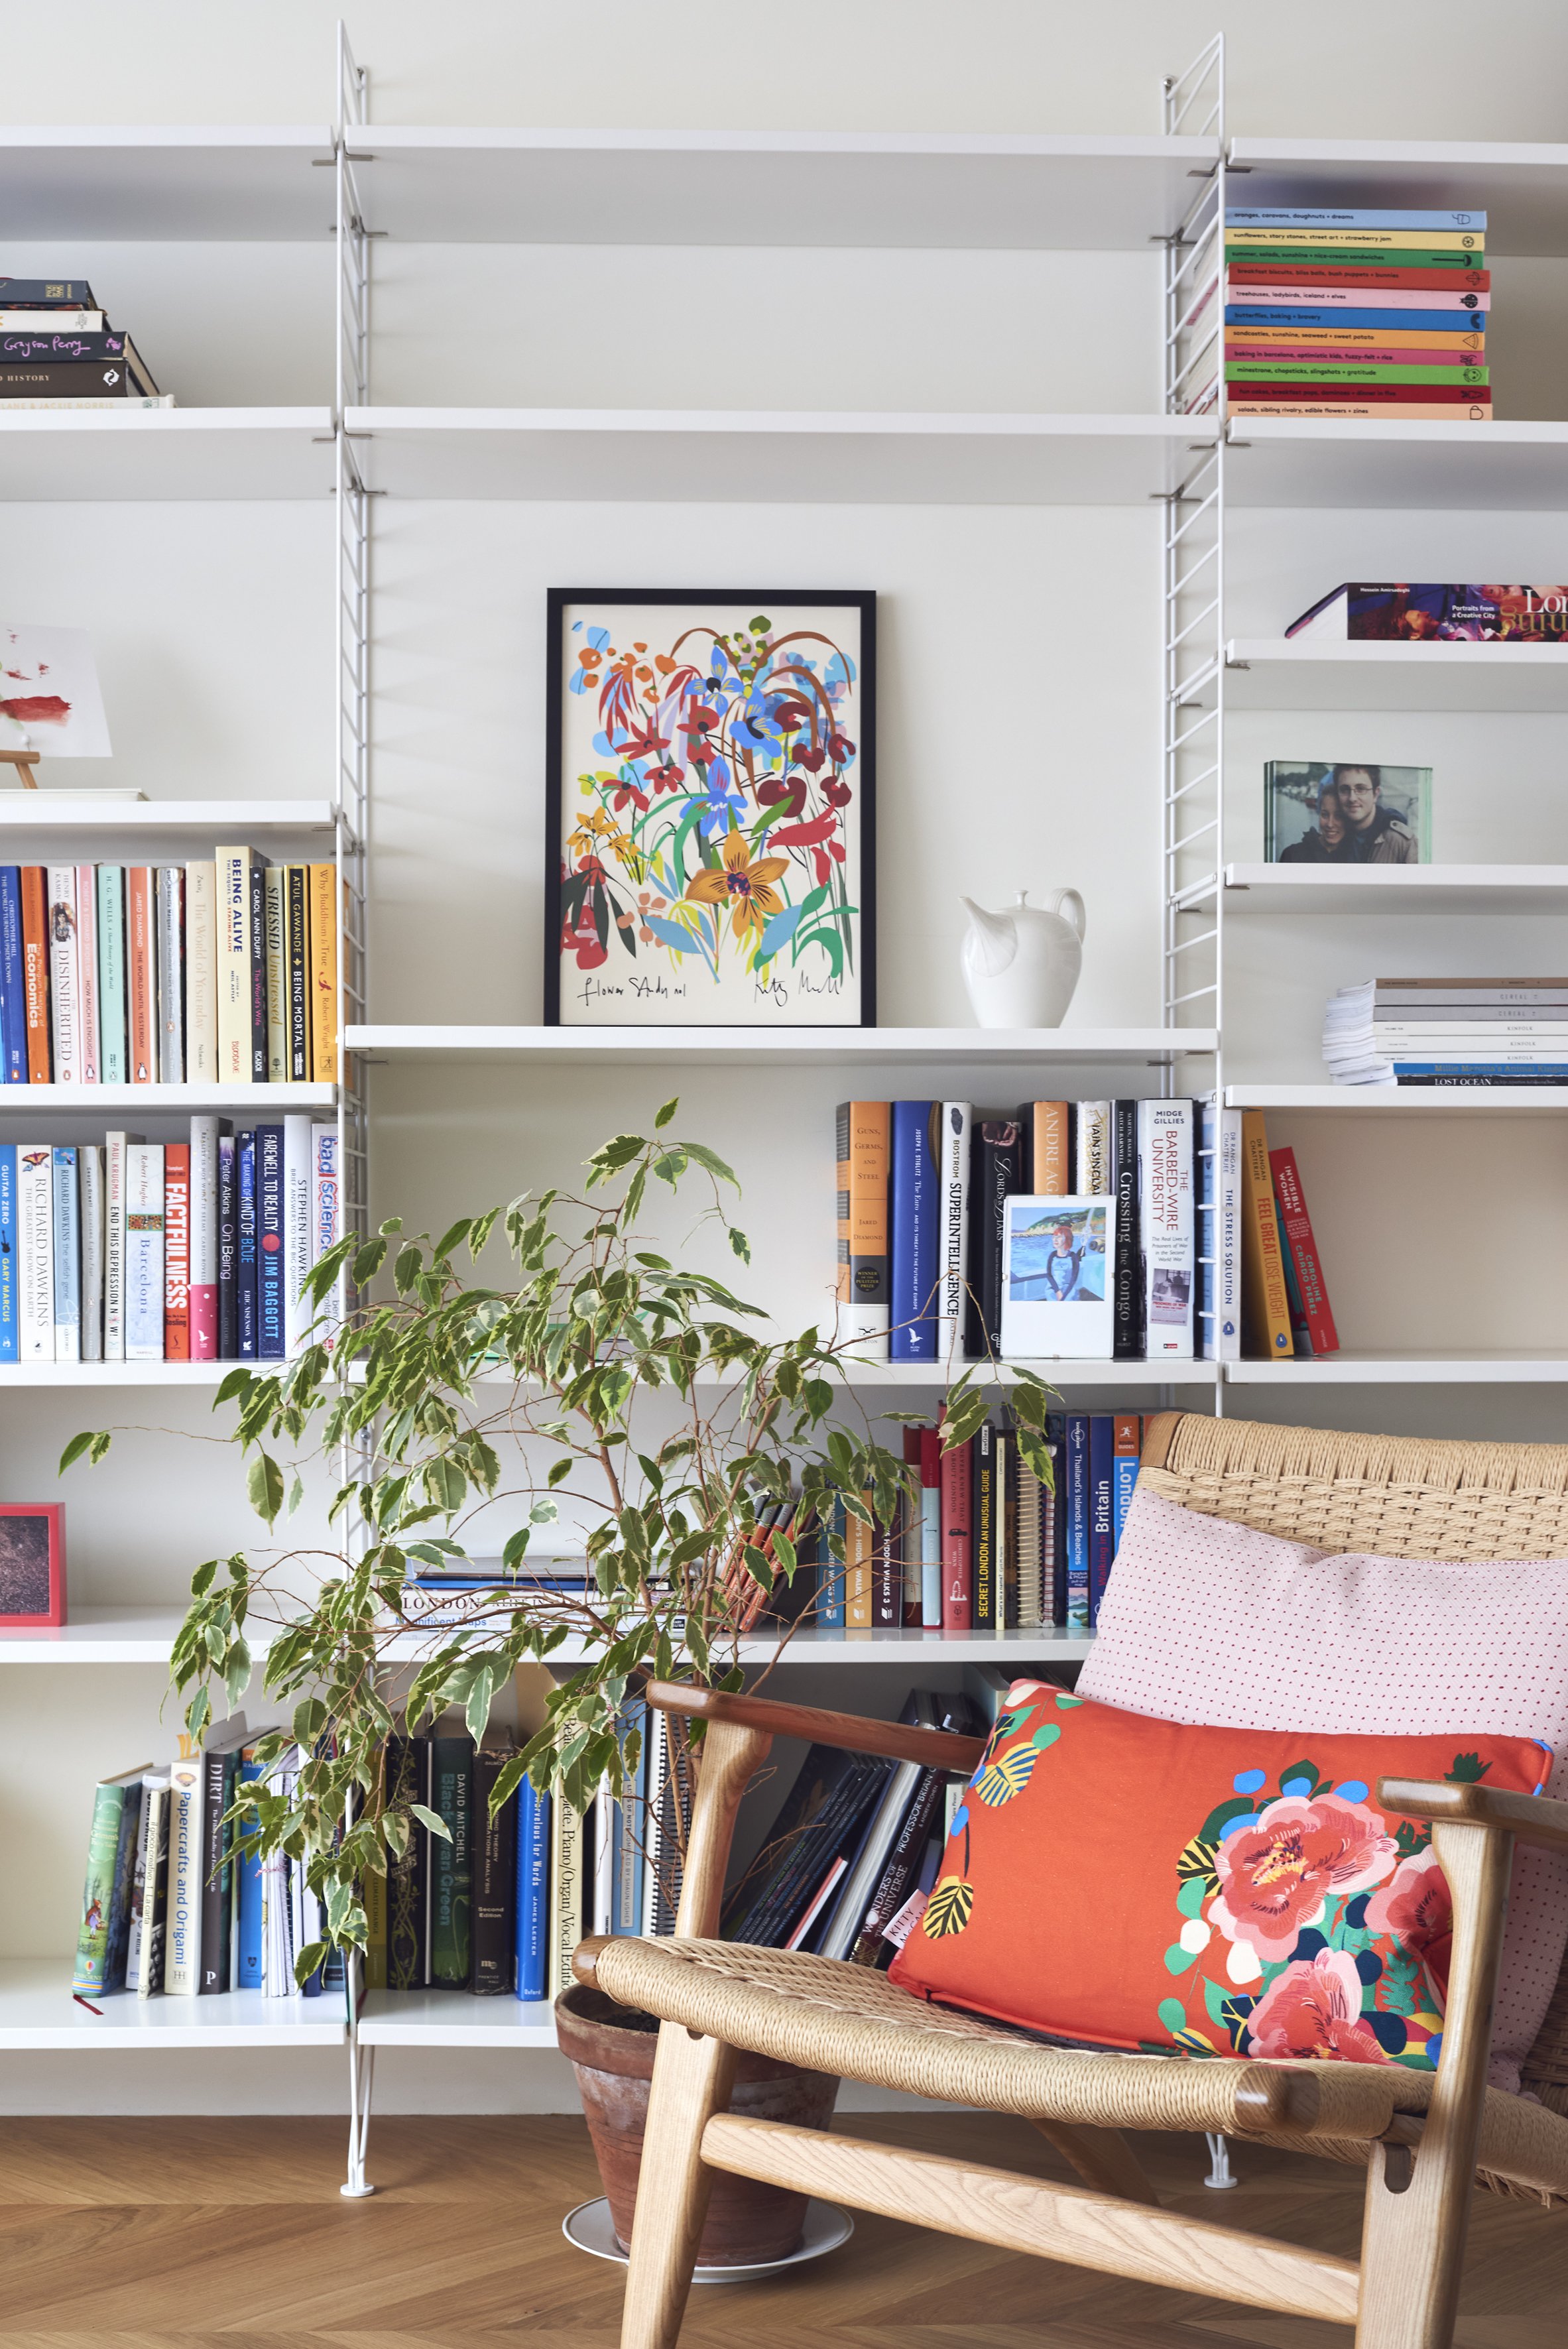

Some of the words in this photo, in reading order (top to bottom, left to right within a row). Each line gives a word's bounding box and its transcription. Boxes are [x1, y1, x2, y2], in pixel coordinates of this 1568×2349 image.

[4, 337, 48, 357] Grayson
[52, 335, 91, 356] Perry
[232, 859, 242, 904] BEING
[319, 870, 329, 890] Why
[233, 910, 243, 952] ALIVE
[268, 887, 281, 949] STRESSED
[293, 904, 302, 953] GAWANDE
[319, 894, 329, 935] Buddhism
[321, 946, 330, 966] True
[27, 943, 38, 1028] Economics
[269, 955, 283, 1025] Unstressed
[293, 971, 302, 1002] BEING
[59, 950, 72, 1061] DISINHERITED
[294, 1006, 303, 1048] MORTAL
[322, 1024, 331, 1049] Wright
[1046, 1107, 1059, 1166] ANDRE
[222, 1158, 232, 1183] Peter
[264, 1135, 278, 1177] FAREWELL
[320, 1136, 337, 1175] bad
[61, 1170, 70, 1204] RICHARD
[140, 1180, 149, 1207] Hughes
[264, 1180, 278, 1192] TO
[1152, 1139, 1164, 1223] UNIVERSITY
[1166, 1131, 1178, 1231] BARBED-WIRE
[1179, 1170, 1188, 1191] THE
[1280, 1174, 1292, 1209] WOMEN
[1284, 1166, 1302, 1213] INVISIBLE
[35, 1179, 47, 1250] RICHARD
[110, 1207, 119, 1224] END
[222, 1185, 232, 1215] Atkins
[241, 1196, 253, 1220] KIND
[264, 1195, 278, 1231] REALITY
[298, 1180, 308, 1232] STEPHEN
[1117, 1172, 1133, 1242] Crossing
[1257, 1197, 1273, 1221] FEEL
[62, 1207, 70, 1241] DAWKINS
[110, 1227, 119, 1247] THIS
[221, 1224, 233, 1242] On
[241, 1223, 254, 1236] OF
[1260, 1223, 1277, 1254] GREAT
[166, 1183, 187, 1309] FACTFULNESS
[220, 1246, 233, 1280] Being
[241, 1238, 255, 1264] BLUE
[947, 1183, 962, 1316] SUPERINTELLIGENCE
[1120, 1249, 1129, 1265] the
[110, 1250, 119, 1305] DEPRESSION
[141, 1240, 151, 1314] Barcelona
[265, 1256, 278, 1276] JIM
[1225, 1253, 1233, 1305] SOLUTION
[1264, 1257, 1280, 1280] LOSE
[1296, 1245, 1309, 1282] CRIADO
[1305, 1286, 1318, 1315] PEREZ
[1305, 1254, 1322, 1302] CAROLINE
[37, 1256, 49, 1327] DAWKINS
[265, 1282, 278, 1338] BAGGOTT
[1116, 1269, 1132, 1321] Congo
[1266, 1282, 1285, 1319] WEIGHT
[981, 1469, 990, 1492] GUIDE
[1095, 1480, 1109, 1533] Britain
[981, 1530, 989, 1541] AN
[979, 1543, 989, 1581] LONDON
[403, 1596, 481, 1610] LONDON
[979, 1583, 989, 1618] SECRET
[209, 1762, 224, 1803] DIRT
[456, 1774, 465, 1807] DAVID
[177, 1791, 192, 1874] Papercrafts
[897, 1802, 922, 1854] PROFESSOR
[918, 1775, 934, 1802] BRIAN
[456, 1811, 465, 1864] MITCHELL
[533, 1844, 542, 1856] for
[532, 1860, 542, 1886] Words
[176, 1879, 189, 1905] and
[173, 1911, 188, 1965] Origami
[888, 1907, 914, 1936] KITTY
